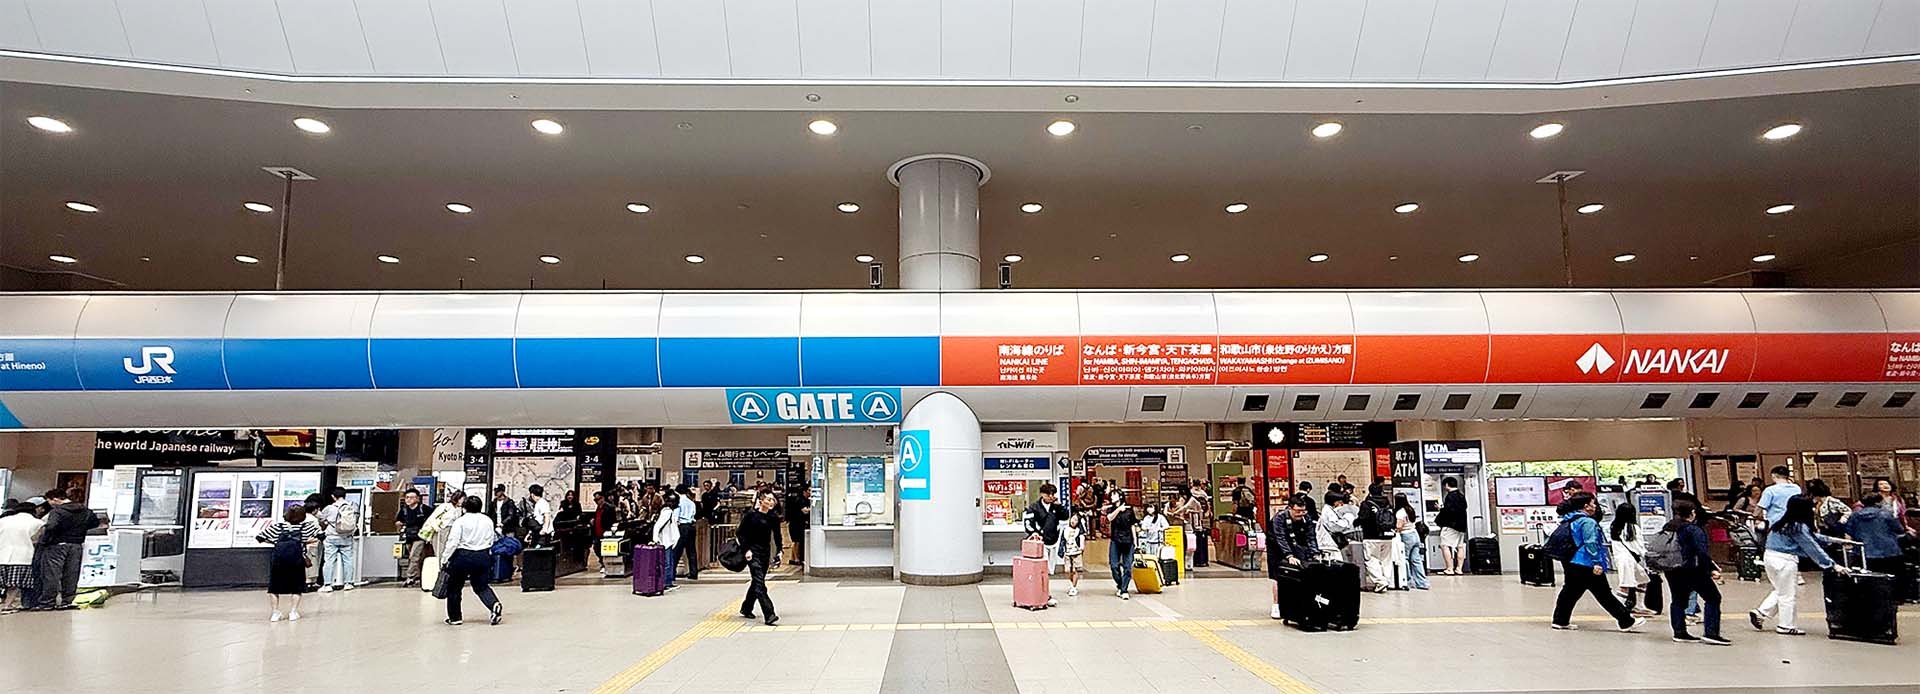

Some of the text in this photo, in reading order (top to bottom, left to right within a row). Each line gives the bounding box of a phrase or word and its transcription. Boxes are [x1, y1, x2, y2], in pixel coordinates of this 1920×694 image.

[998, 344, 1065, 356] 南海線のりば
[124, 346, 177, 374] JR
[999, 358, 1049, 366] NANKAI LINE
[1083, 358, 1093, 366] for
[1623, 349, 1729, 374] NANKAI
[740, 392, 894, 420] A GATE A
[114, 440, 148, 450] world
[149, 441, 198, 453] Japanese
[200, 443, 236, 455] railway.
[438, 451, 457, 463] Kyoto
[1393, 463, 1418, 478] ATM
